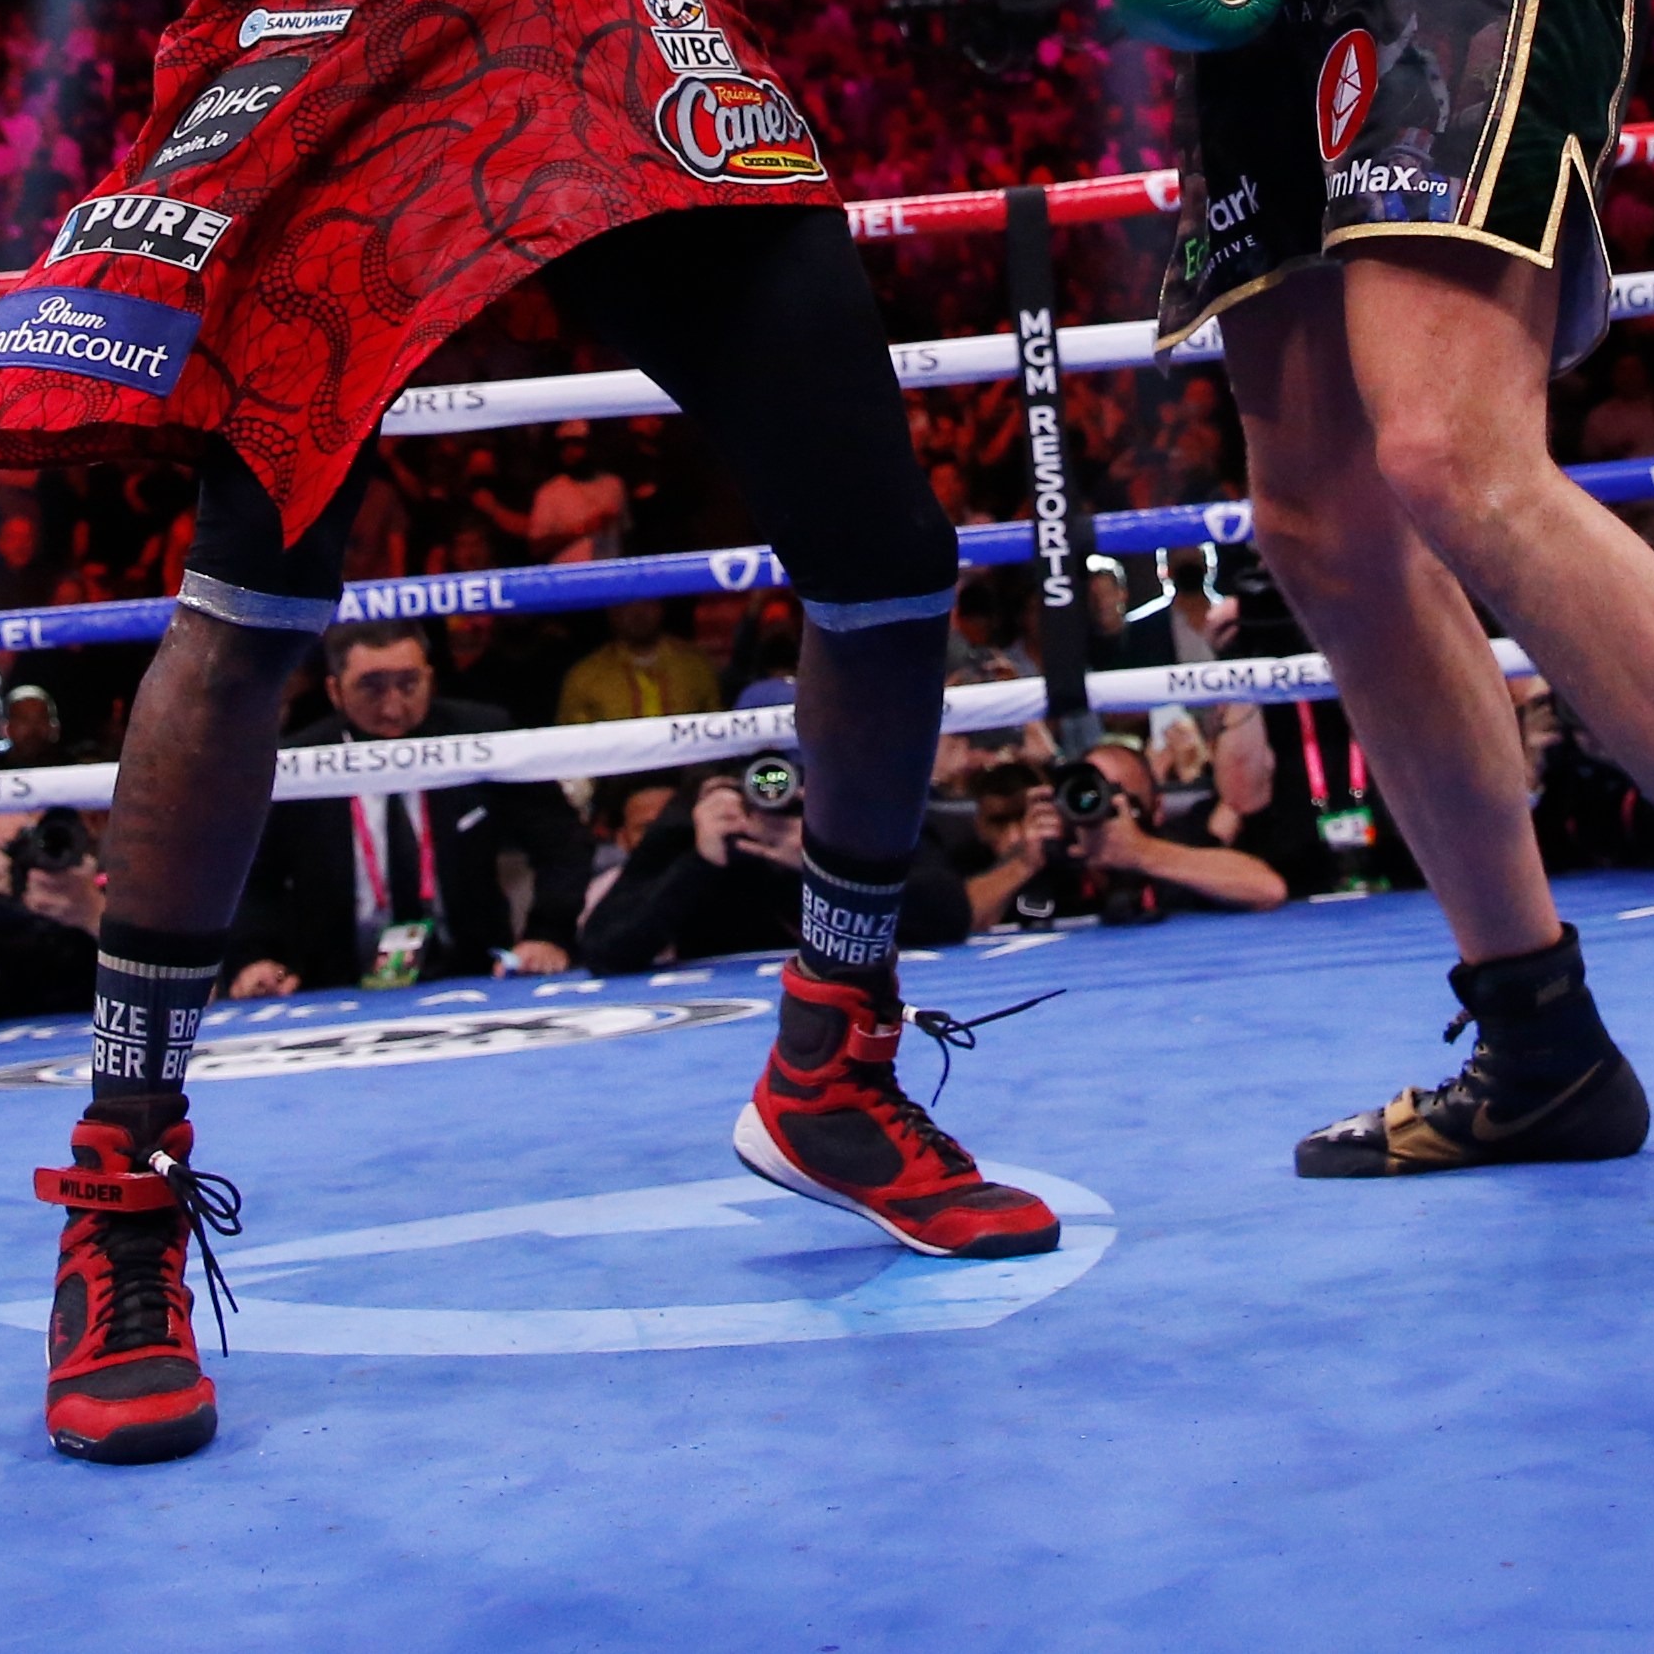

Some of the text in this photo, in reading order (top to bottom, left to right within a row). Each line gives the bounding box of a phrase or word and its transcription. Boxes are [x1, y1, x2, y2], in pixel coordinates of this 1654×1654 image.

[265, 13, 348, 30] SANUWAVE
[659, 36, 732, 66] WBC
[210, 84, 283, 120] IHC
[676, 81, 803, 170] Cane's
[82, 197, 226, 247] PURE
[30, 296, 107, 330] Rhum
[1017, 307, 1057, 396] MGM
[1028, 405, 1074, 608] RESORTS
[337, 576, 515, 622] ANDUEL
[1166, 664, 1263, 694] MGM
[670, 712, 763, 744] MGM
[312, 737, 494, 776] RESORTS
[801, 882, 898, 938] BRONZ
[57, 1176, 124, 1204] WILDER
